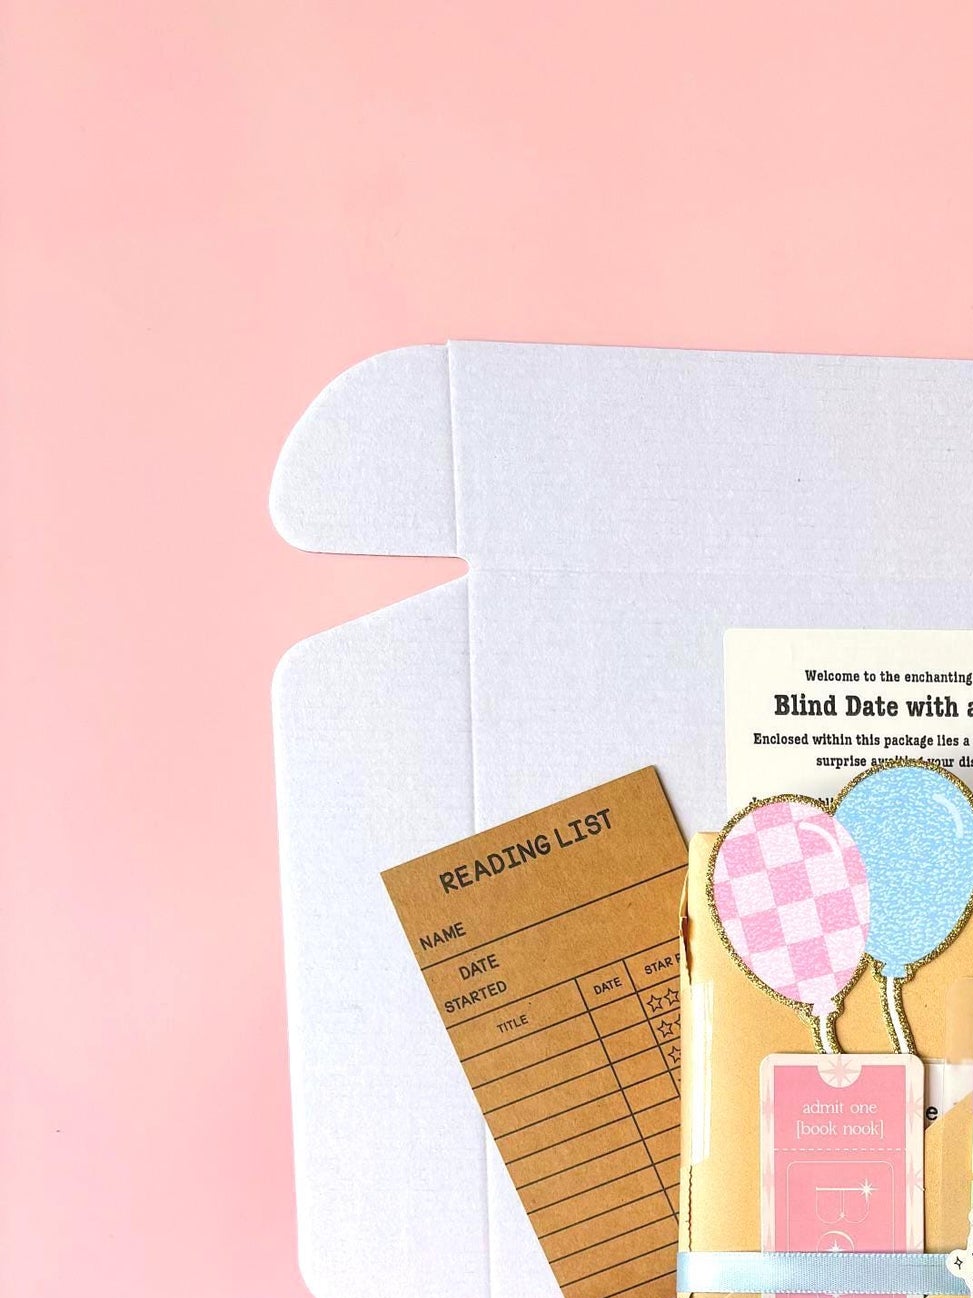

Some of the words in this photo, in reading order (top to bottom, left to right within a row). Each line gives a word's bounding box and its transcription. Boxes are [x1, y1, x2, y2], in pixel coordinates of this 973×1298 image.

[804, 669, 860, 682] Welcome
[863, 670, 877, 682] to
[879, 670, 901, 683] the
[904, 671, 973, 687] enchanting
[774, 693, 838, 717] Blind
[845, 695, 899, 717] Date
[905, 694, 960, 718] with
[753, 732, 809, 745] Enclosed
[812, 733, 853, 746] within
[855, 733, 880, 746] this
[883, 734, 934, 750] package
[937, 734, 959, 747] lies
[962, 737, 970, 747] a
[816, 755, 867, 770] surprise
[439, 835, 551, 894] READING
[554, 808, 612, 849] LIST
[419, 922, 467, 951] NAME
[458, 954, 501, 981] DATE
[644, 957, 673, 975] STAR
[593, 977, 622, 995] DATE
[444, 980, 508, 1014] STARTED
[496, 1015, 529, 1035] TITLE
[802, 1099, 844, 1114] admit
[850, 1103, 877, 1114] one
[796, 1119, 837, 1140] [book
[843, 1119, 884, 1140] nook]
